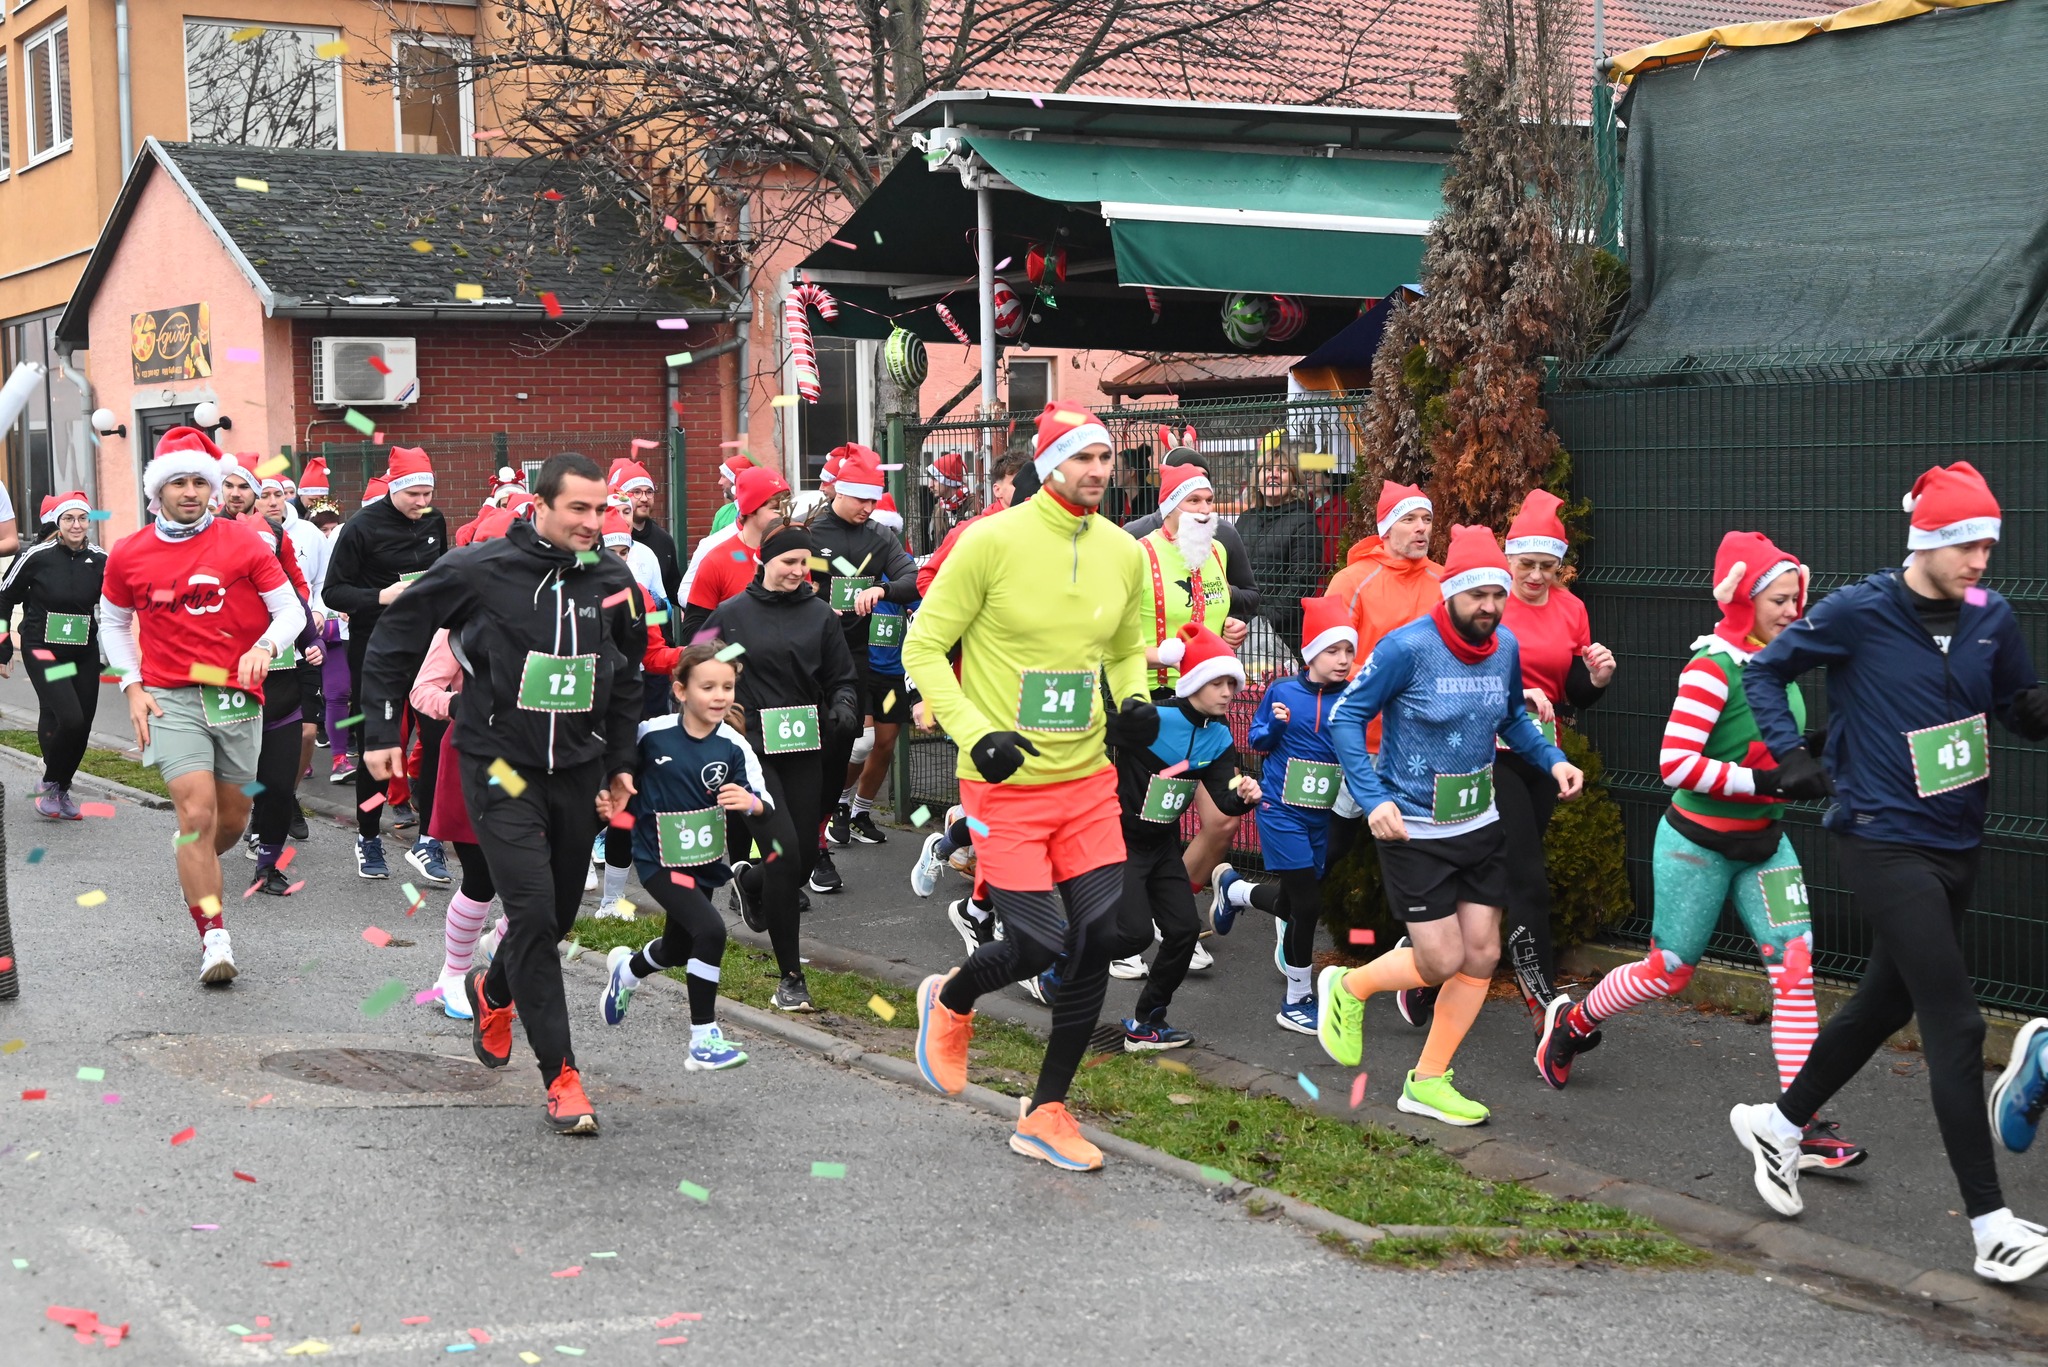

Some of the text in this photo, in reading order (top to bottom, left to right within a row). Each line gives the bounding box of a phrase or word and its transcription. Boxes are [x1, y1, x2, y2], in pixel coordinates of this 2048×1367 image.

[62, 623, 72, 636] 4
[876, 623, 894, 638] 56
[548, 673, 577, 696] 12
[1435, 675, 1505, 695] HRVATSKA
[217, 690, 247, 711] 20
[1041, 688, 1076, 713] 24
[778, 720, 806, 740] 60
[1937, 739, 1972, 770] 43
[1301, 775, 1330, 795] 89
[1161, 792, 1186, 811] 88
[1457, 786, 1479, 808] 11
[678, 824, 713, 850] 96
